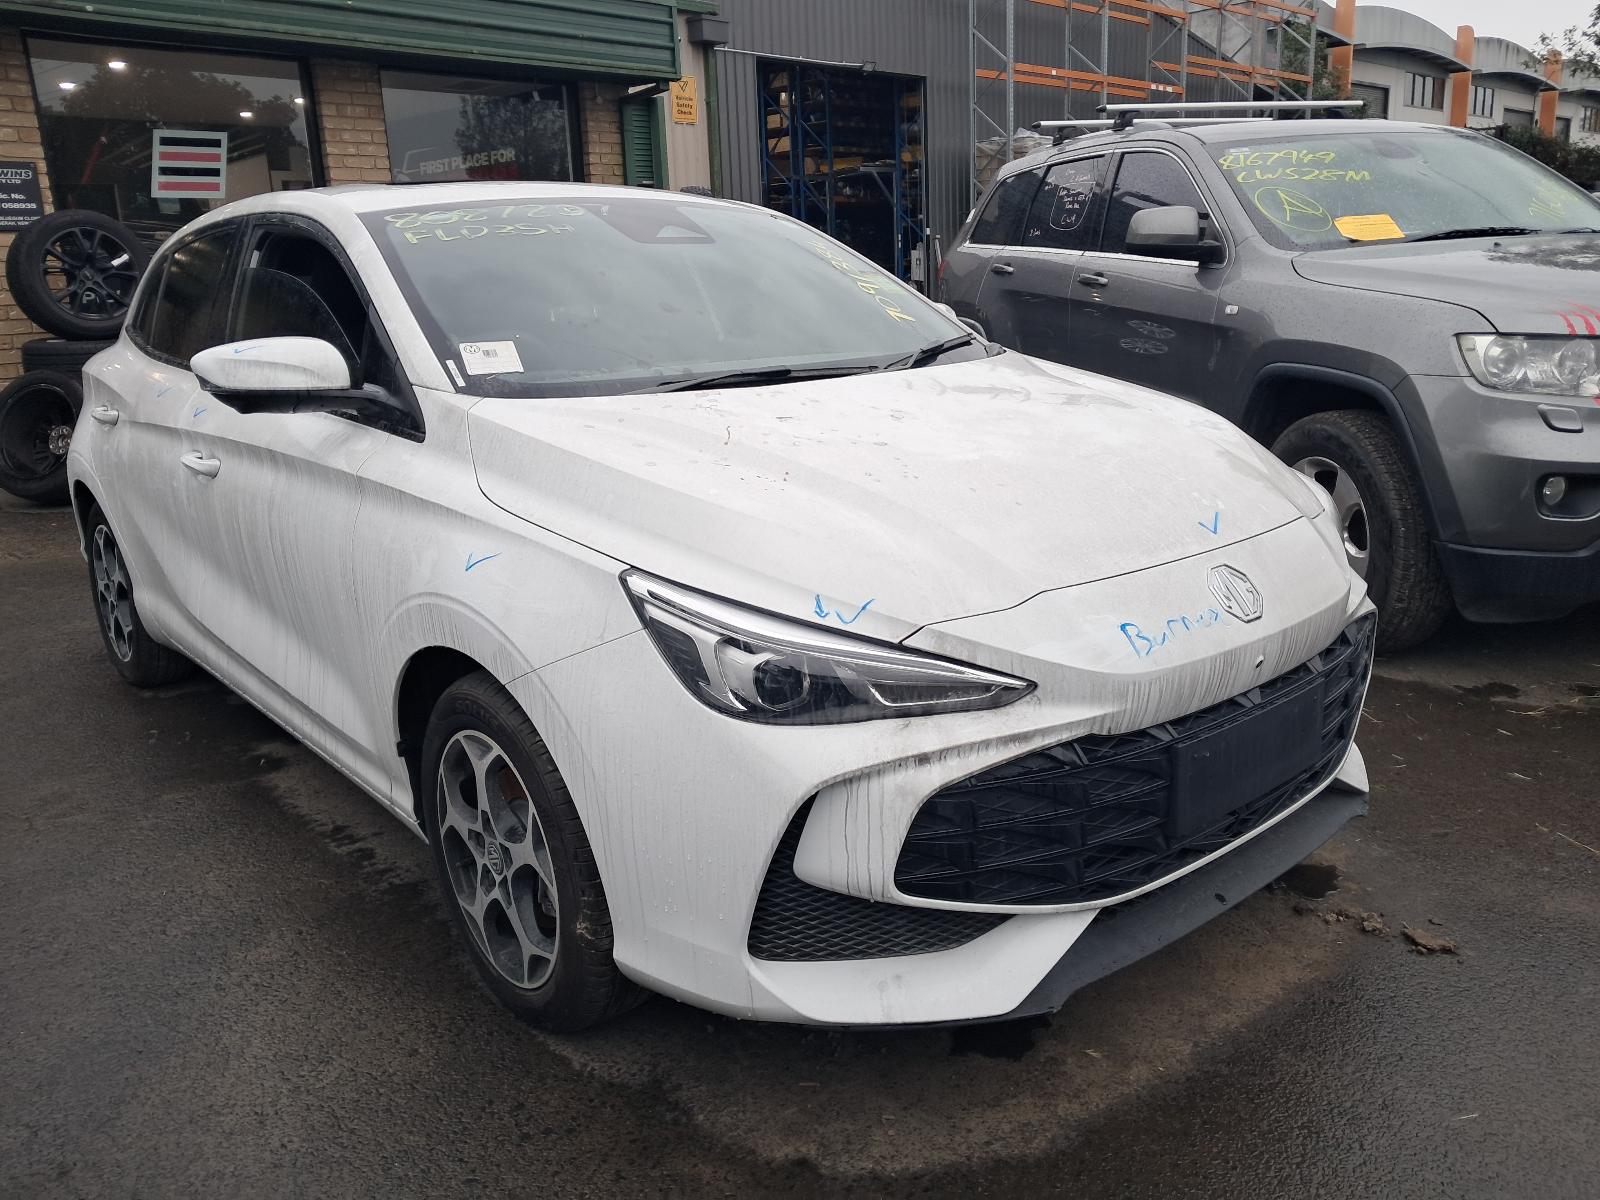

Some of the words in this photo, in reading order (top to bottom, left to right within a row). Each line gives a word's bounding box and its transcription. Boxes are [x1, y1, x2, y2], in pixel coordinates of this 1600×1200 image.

[419, 158, 449, 175] FIRST
[451, 152, 489, 169] PLACE
[490, 148, 516, 165] FOR
[1208, 564, 1263, 623] MG
